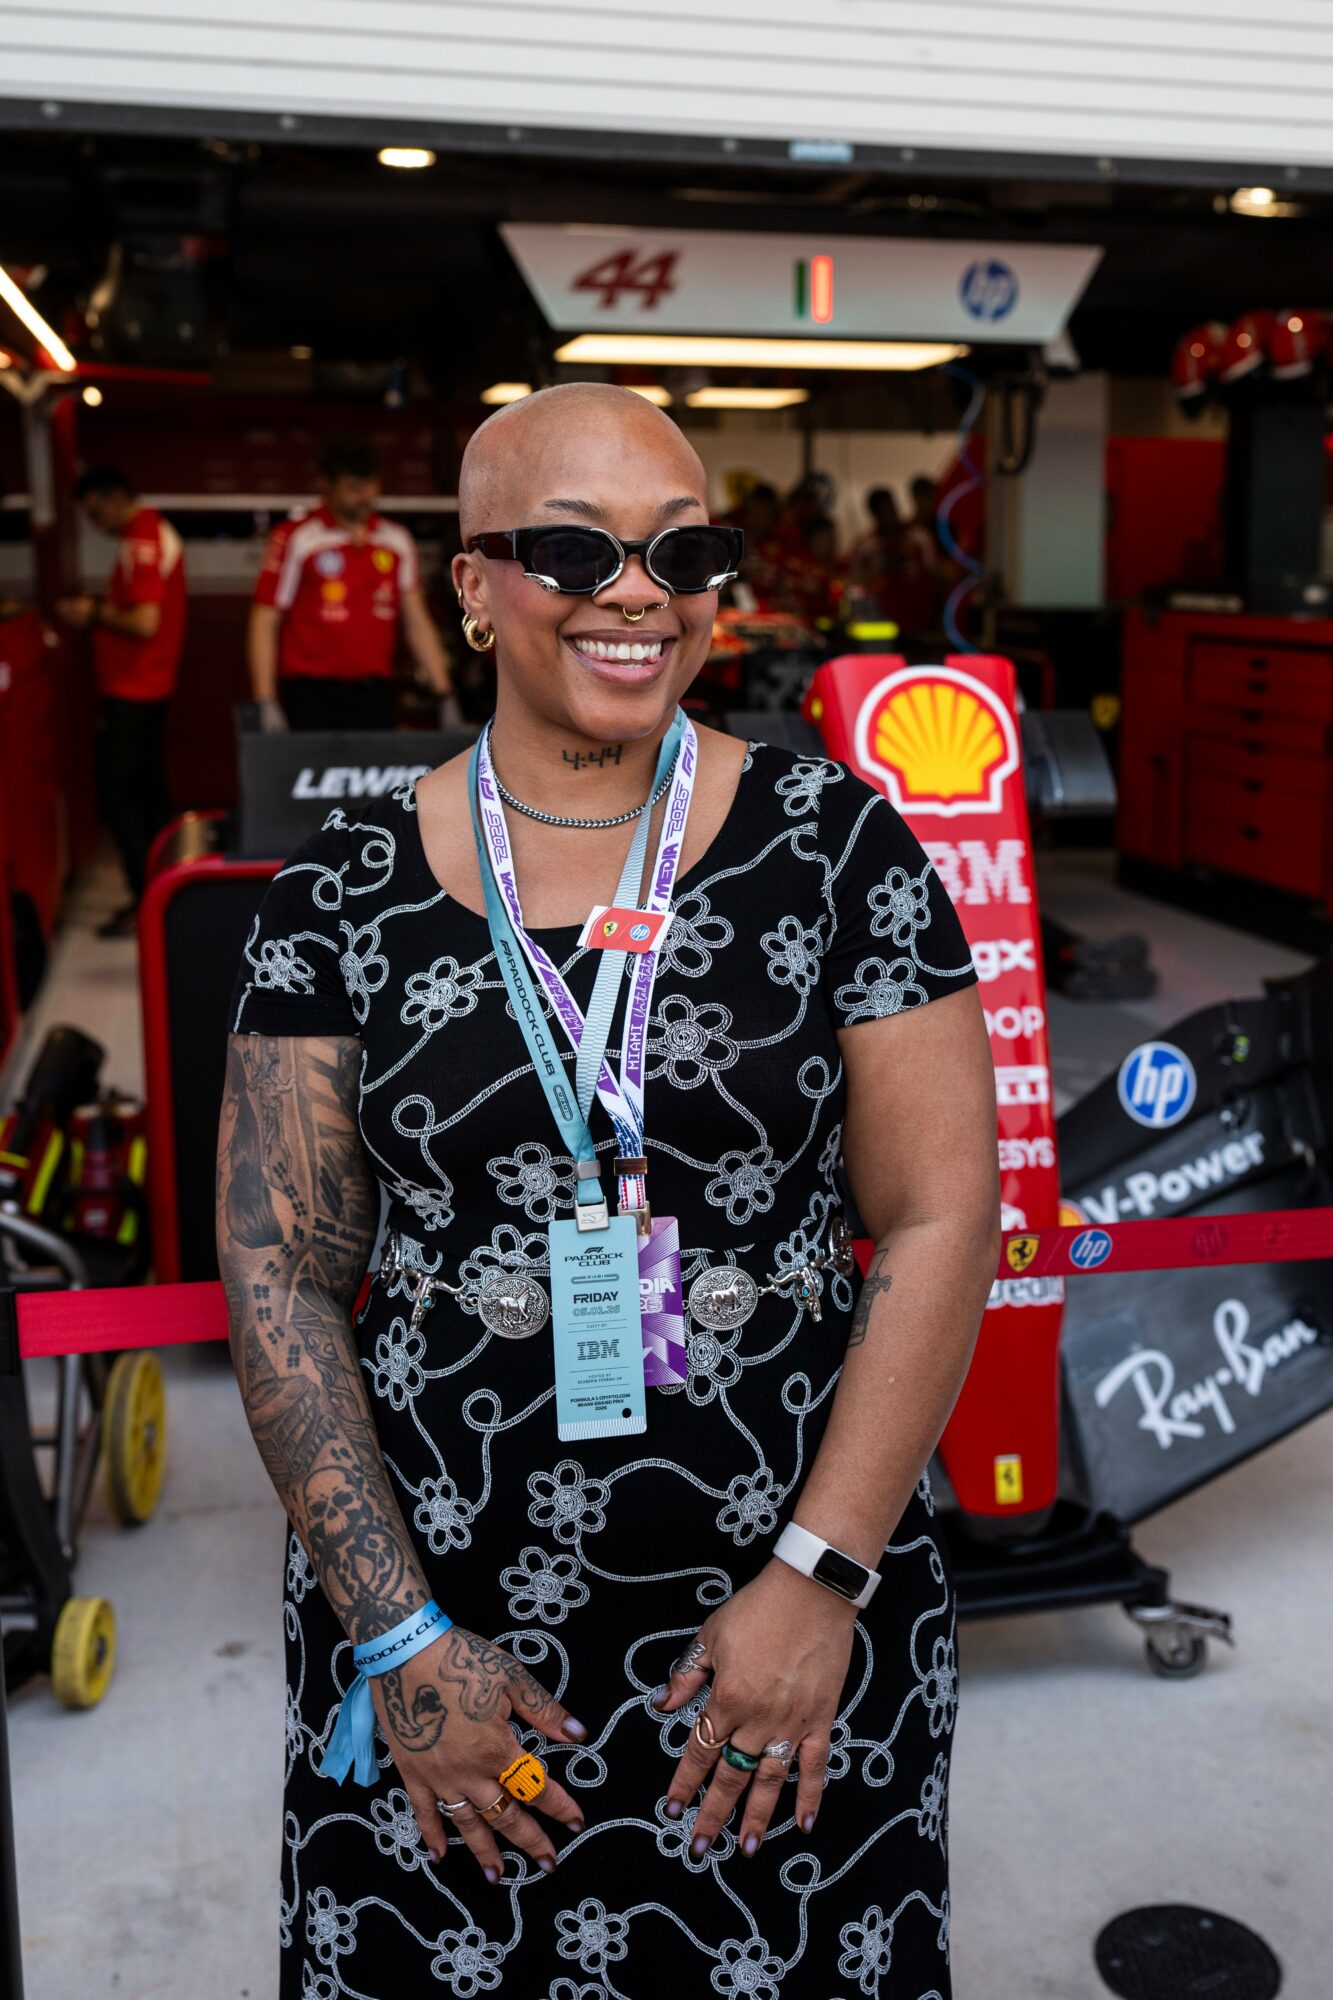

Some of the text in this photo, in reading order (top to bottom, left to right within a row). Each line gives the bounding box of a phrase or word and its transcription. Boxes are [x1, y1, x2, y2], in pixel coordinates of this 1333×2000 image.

[571, 247, 682, 312] 44
[970, 259, 1013, 323] hp
[562, 744, 623, 771] 4:44
[484, 808, 508, 865] 2026
[654, 843, 678, 900] MEDIA
[666, 779, 689, 841] 2026
[920, 839, 1032, 905] BM
[632, 924, 649, 941] hp
[970, 938, 1036, 983] gx
[508, 958, 539, 1032] PADDOCK
[534, 1033, 556, 1076] CLUB
[627, 1024, 643, 1070] MIAMI
[1130, 1043, 1189, 1126] hp
[998, 1136, 1056, 1171] ESYS
[1080, 1131, 1265, 1224] V-Power
[564, 1252, 623, 1262] PADDOCK
[1073, 1230, 1109, 1268] hp
[573, 1291, 619, 1304] FRIDAY
[639, 1277, 676, 1295] DIA
[577, 1338, 620, 1360] IBM
